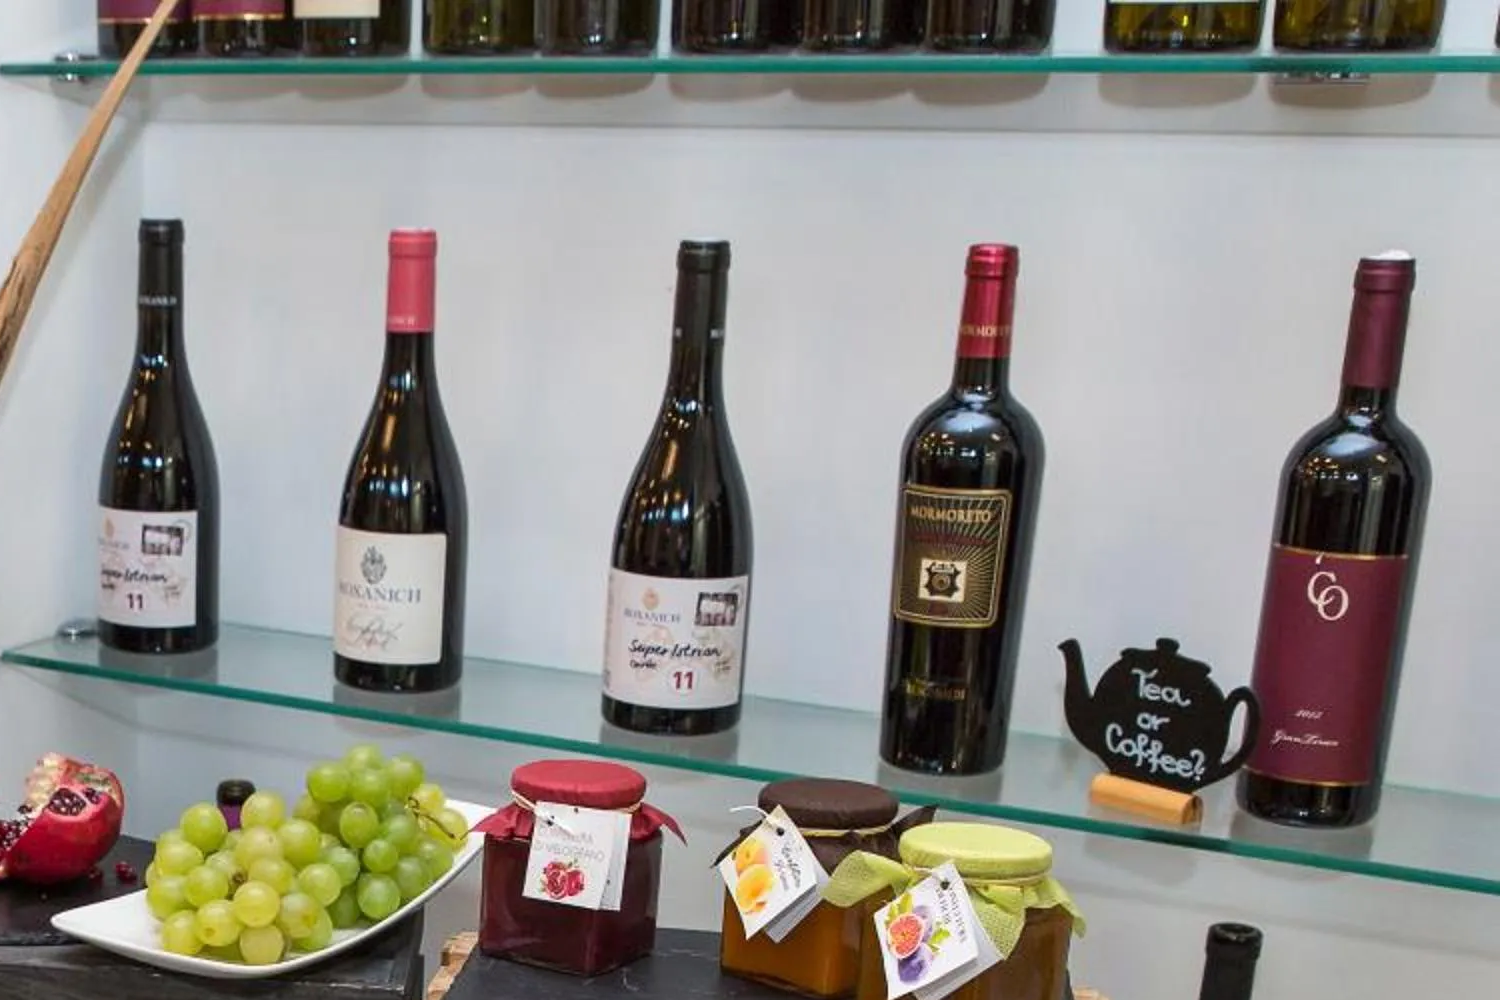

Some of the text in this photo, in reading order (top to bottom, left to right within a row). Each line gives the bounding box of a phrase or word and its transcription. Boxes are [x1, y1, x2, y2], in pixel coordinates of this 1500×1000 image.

[126, 592, 144, 610] 11
[627, 638, 670, 660] Super
[673, 671, 695, 691] 11
[1130, 666, 1193, 708] Tea
[1136, 711, 1172, 732] or
[1104, 722, 1207, 782] Coffee?
